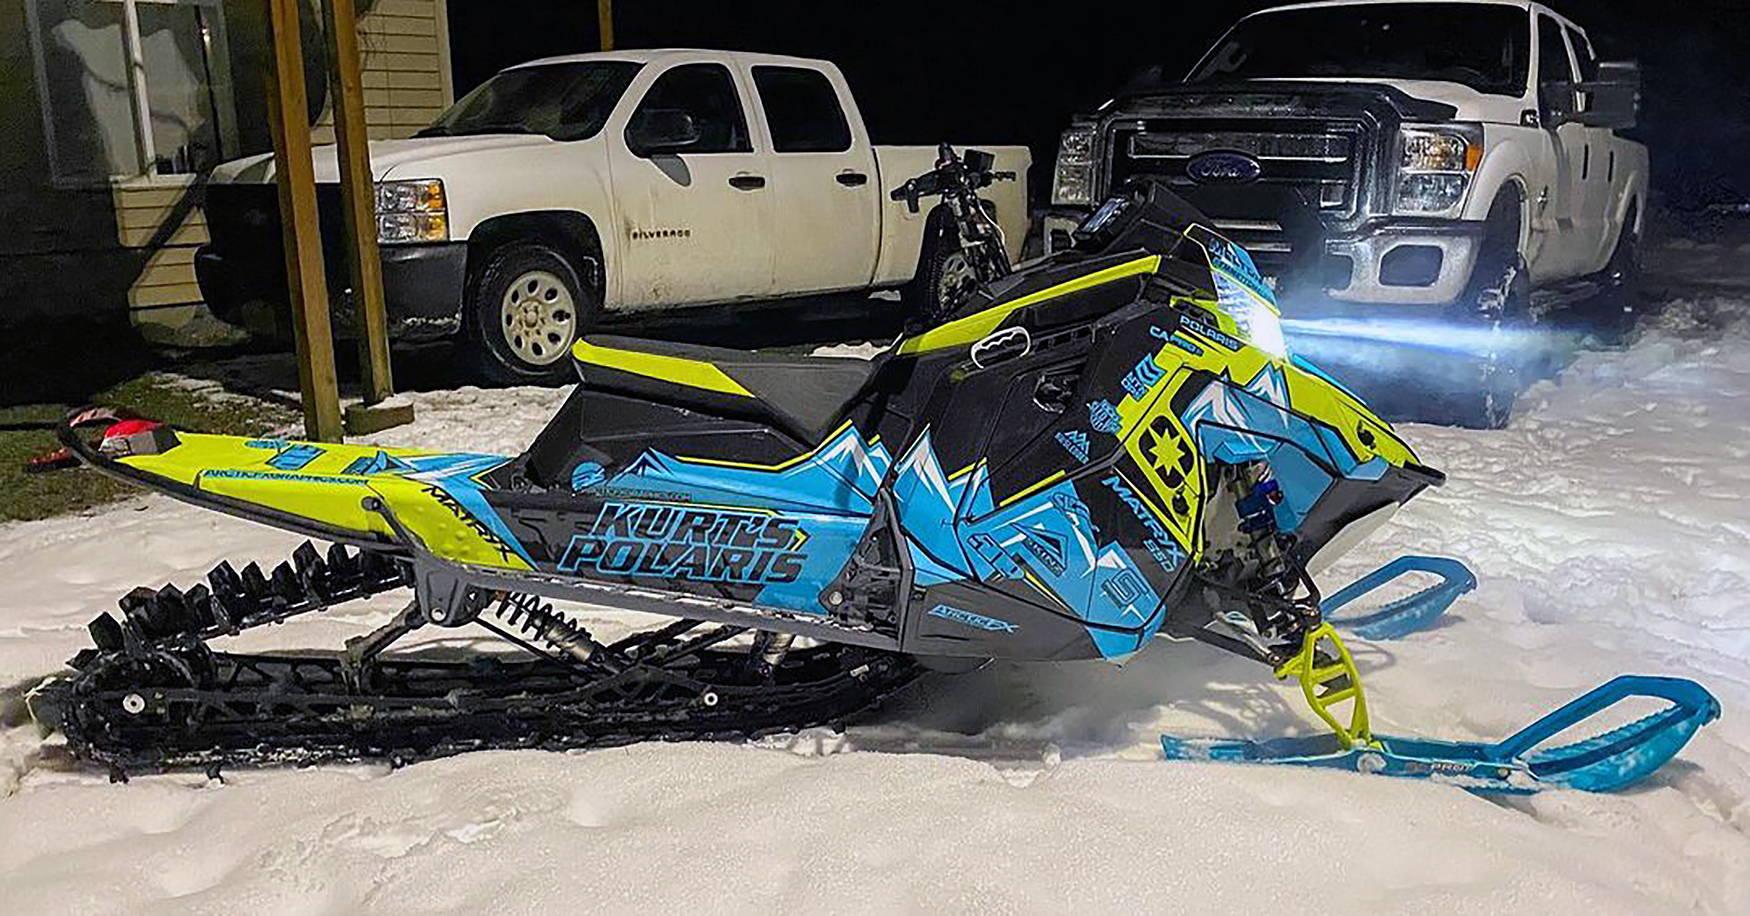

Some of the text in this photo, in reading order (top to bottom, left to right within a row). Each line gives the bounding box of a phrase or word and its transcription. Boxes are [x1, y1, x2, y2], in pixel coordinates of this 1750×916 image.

[1180, 315, 1238, 350] POLARIS
[592, 502, 799, 551] KURT'S
[1101, 475, 1186, 569] MATRYX
[557, 534, 808, 584] POLARIS
